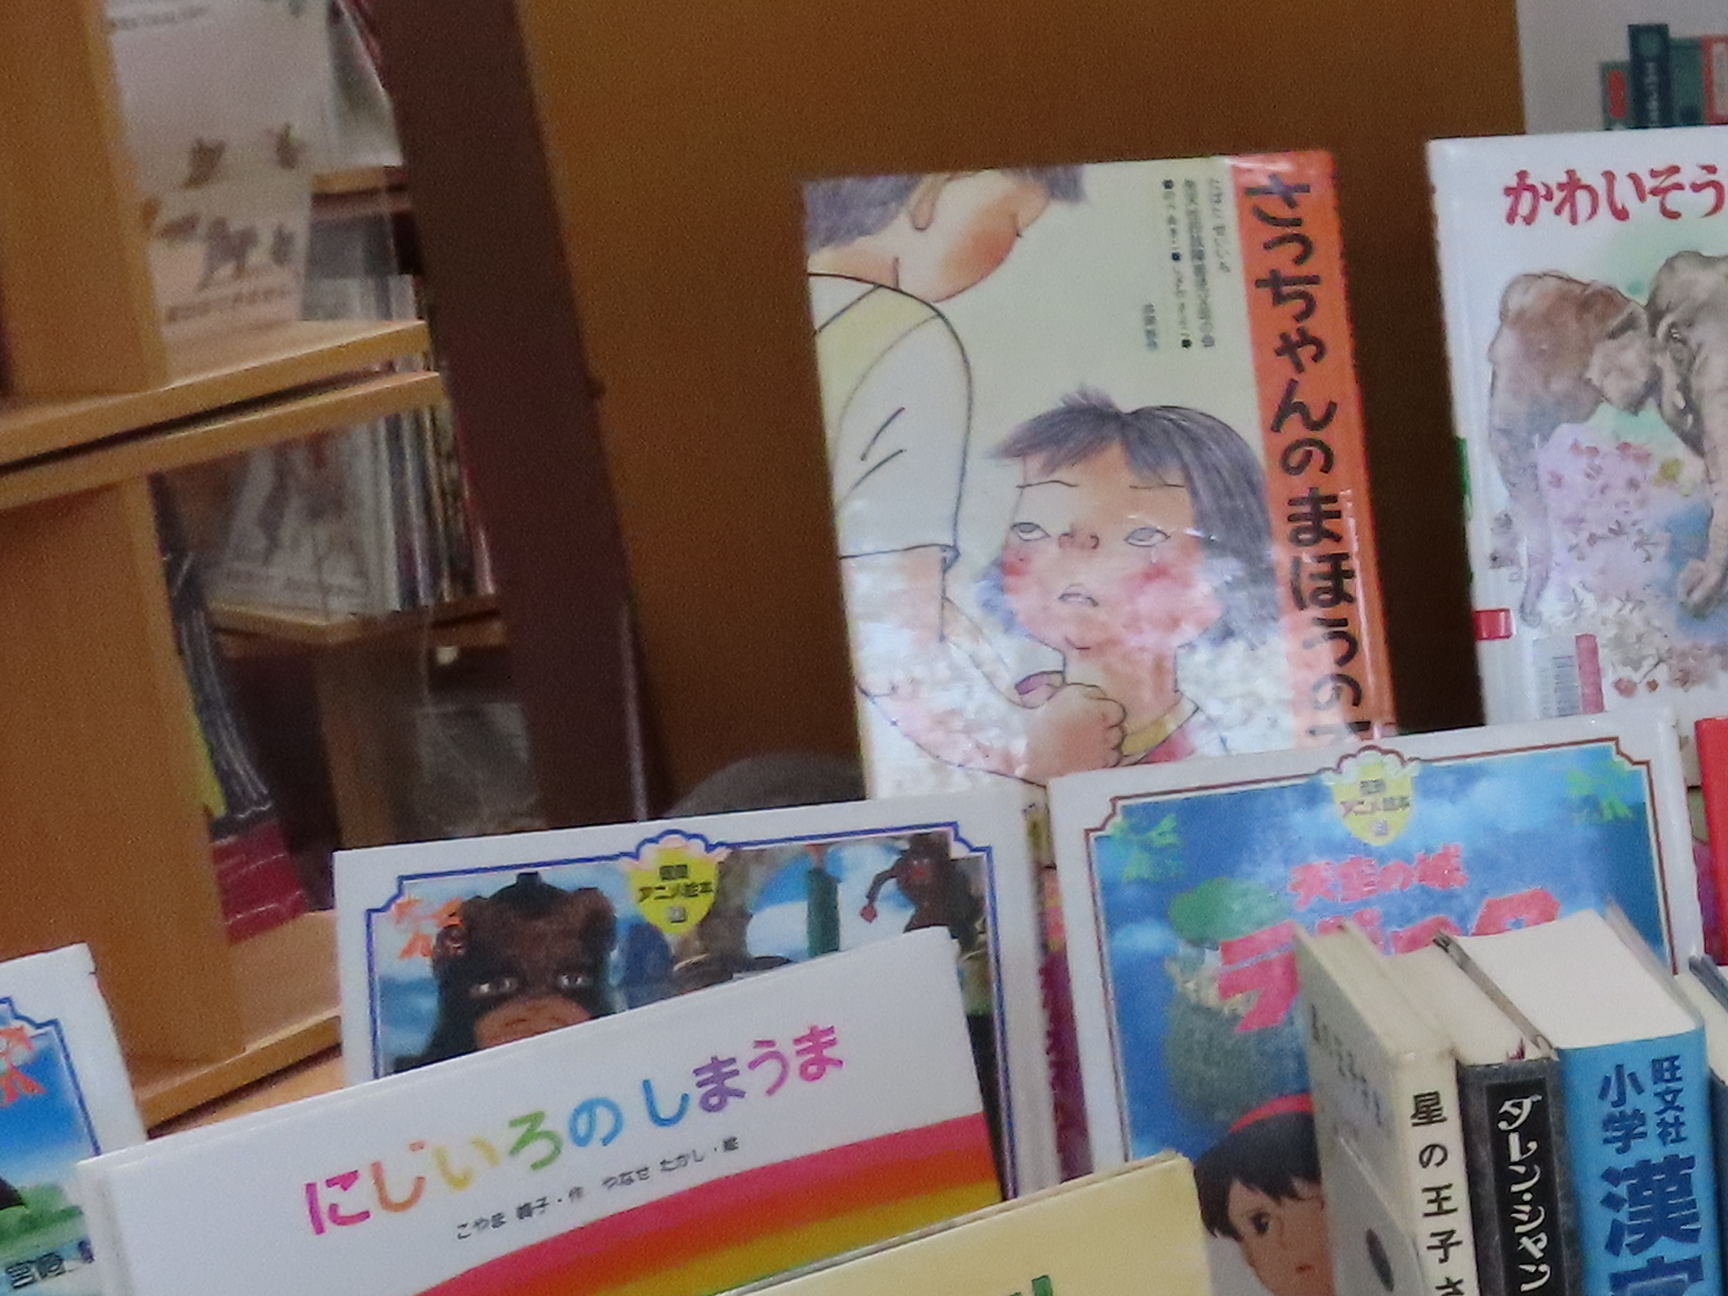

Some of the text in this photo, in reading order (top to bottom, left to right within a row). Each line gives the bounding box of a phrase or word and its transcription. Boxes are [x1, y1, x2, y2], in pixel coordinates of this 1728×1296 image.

[1245, 174, 1373, 744] さっちゃんのまほうの
[1651, 1054, 1688, 1144] 旺文社
